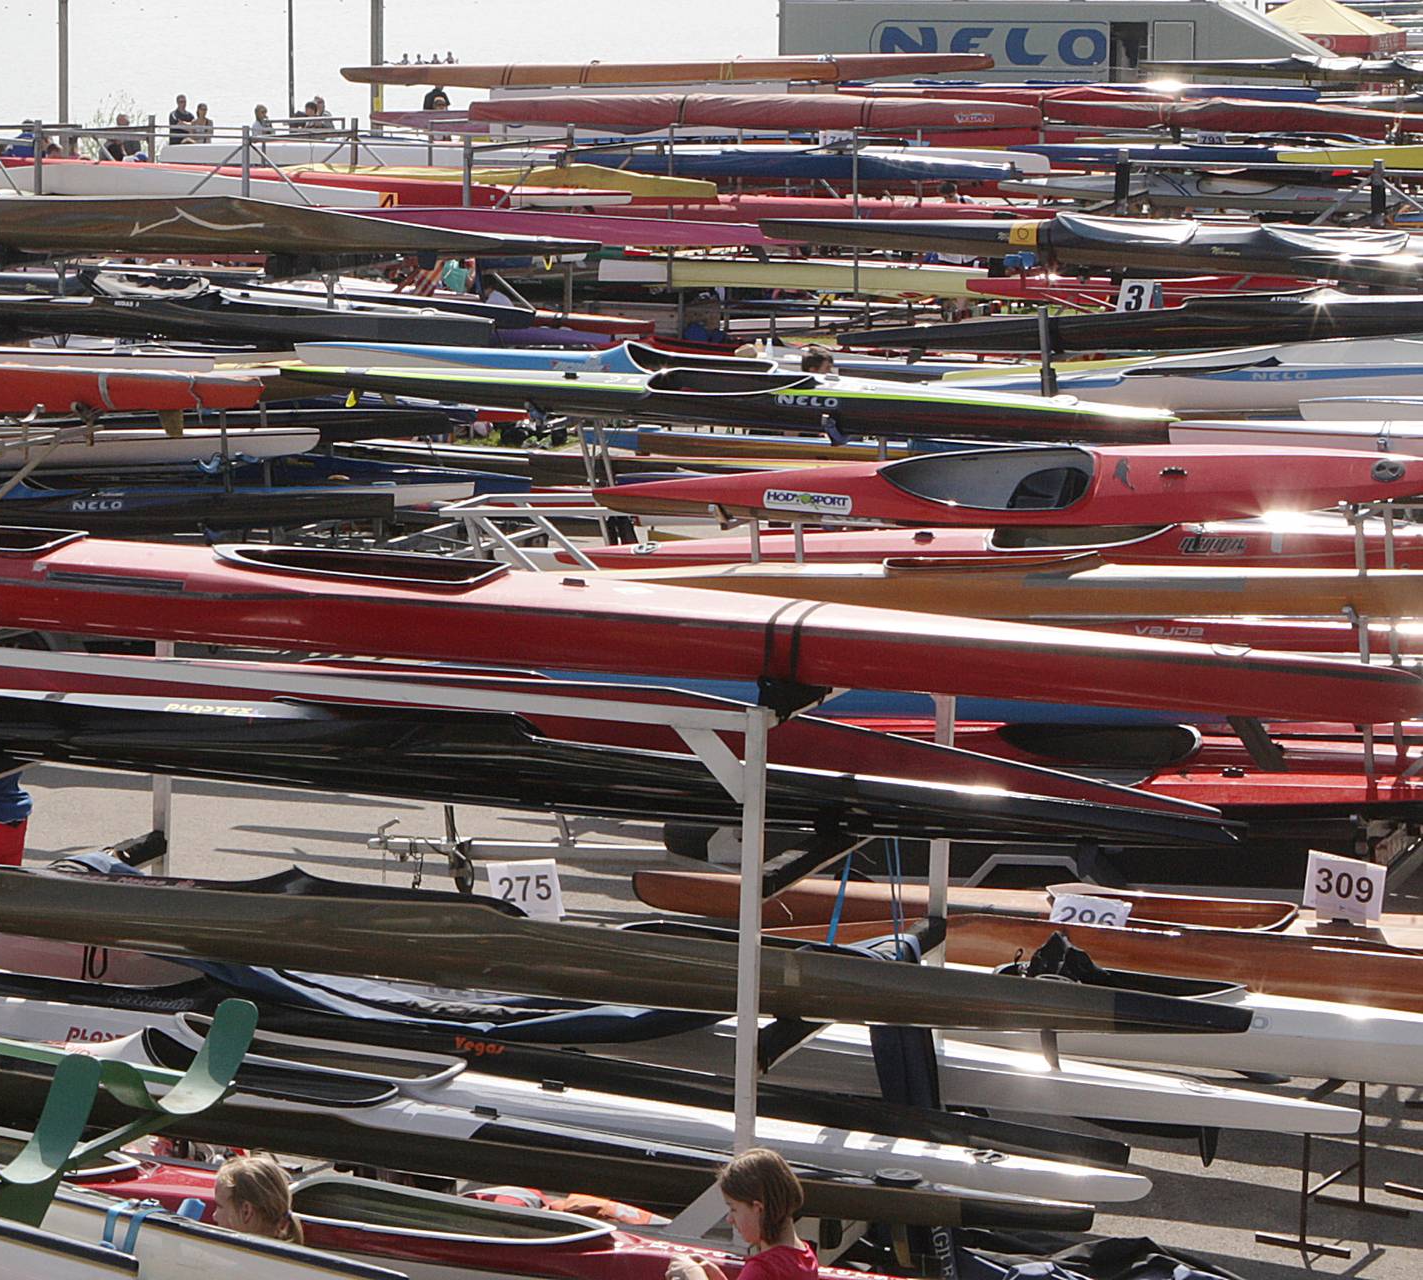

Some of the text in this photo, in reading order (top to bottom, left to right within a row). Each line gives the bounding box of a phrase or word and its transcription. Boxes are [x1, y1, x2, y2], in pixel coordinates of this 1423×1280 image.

[880, 27, 1106, 65] NELO
[1125, 284, 1144, 311] 3
[778, 395, 838, 407] NELO
[73, 501, 123, 510] NELO
[499, 875, 552, 902] 275
[1315, 868, 1373, 903] 309
